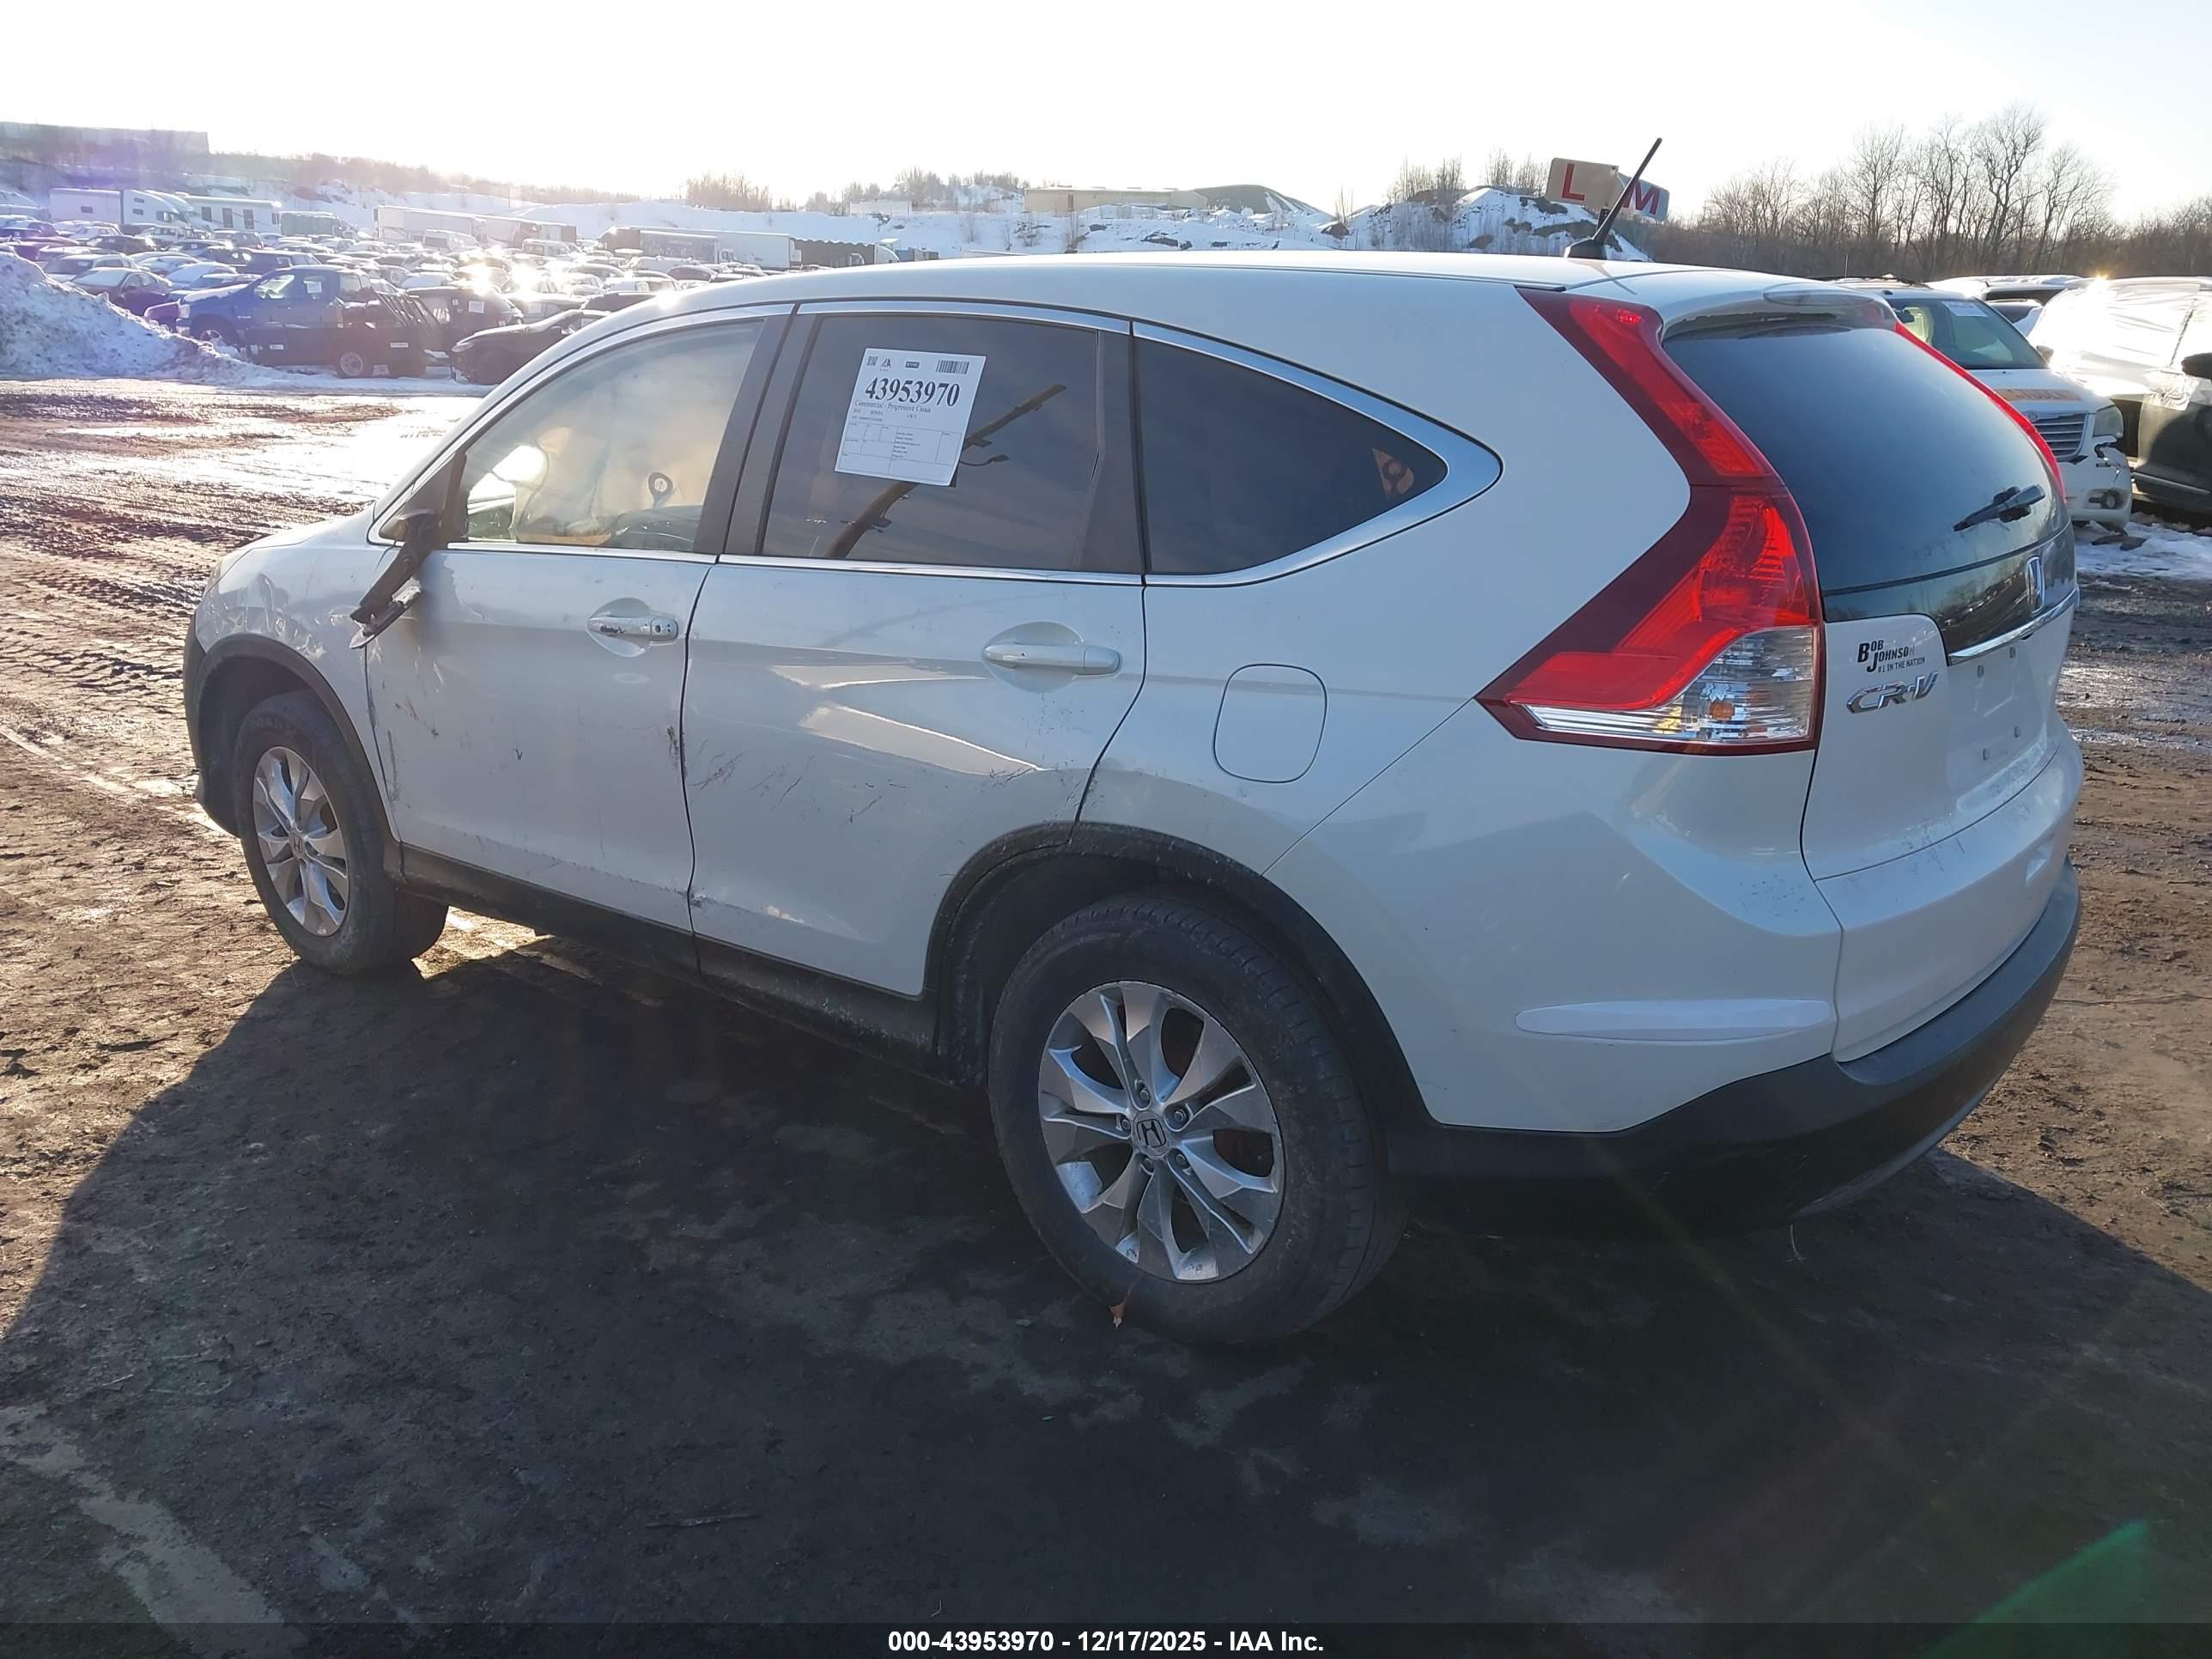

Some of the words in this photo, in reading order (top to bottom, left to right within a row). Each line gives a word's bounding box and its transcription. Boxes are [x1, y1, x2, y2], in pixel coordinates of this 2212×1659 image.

[1561, 163, 1585, 201] L
[1621, 179, 1661, 215] M
[865, 377, 960, 407] 43953970
[1857, 640, 1885, 663] BOB
[1887, 663, 1894, 672] IN
[1894, 660, 1905, 670] THE
[1905, 657, 1925, 667] NATION
[1846, 672, 1939, 714] CR-V
